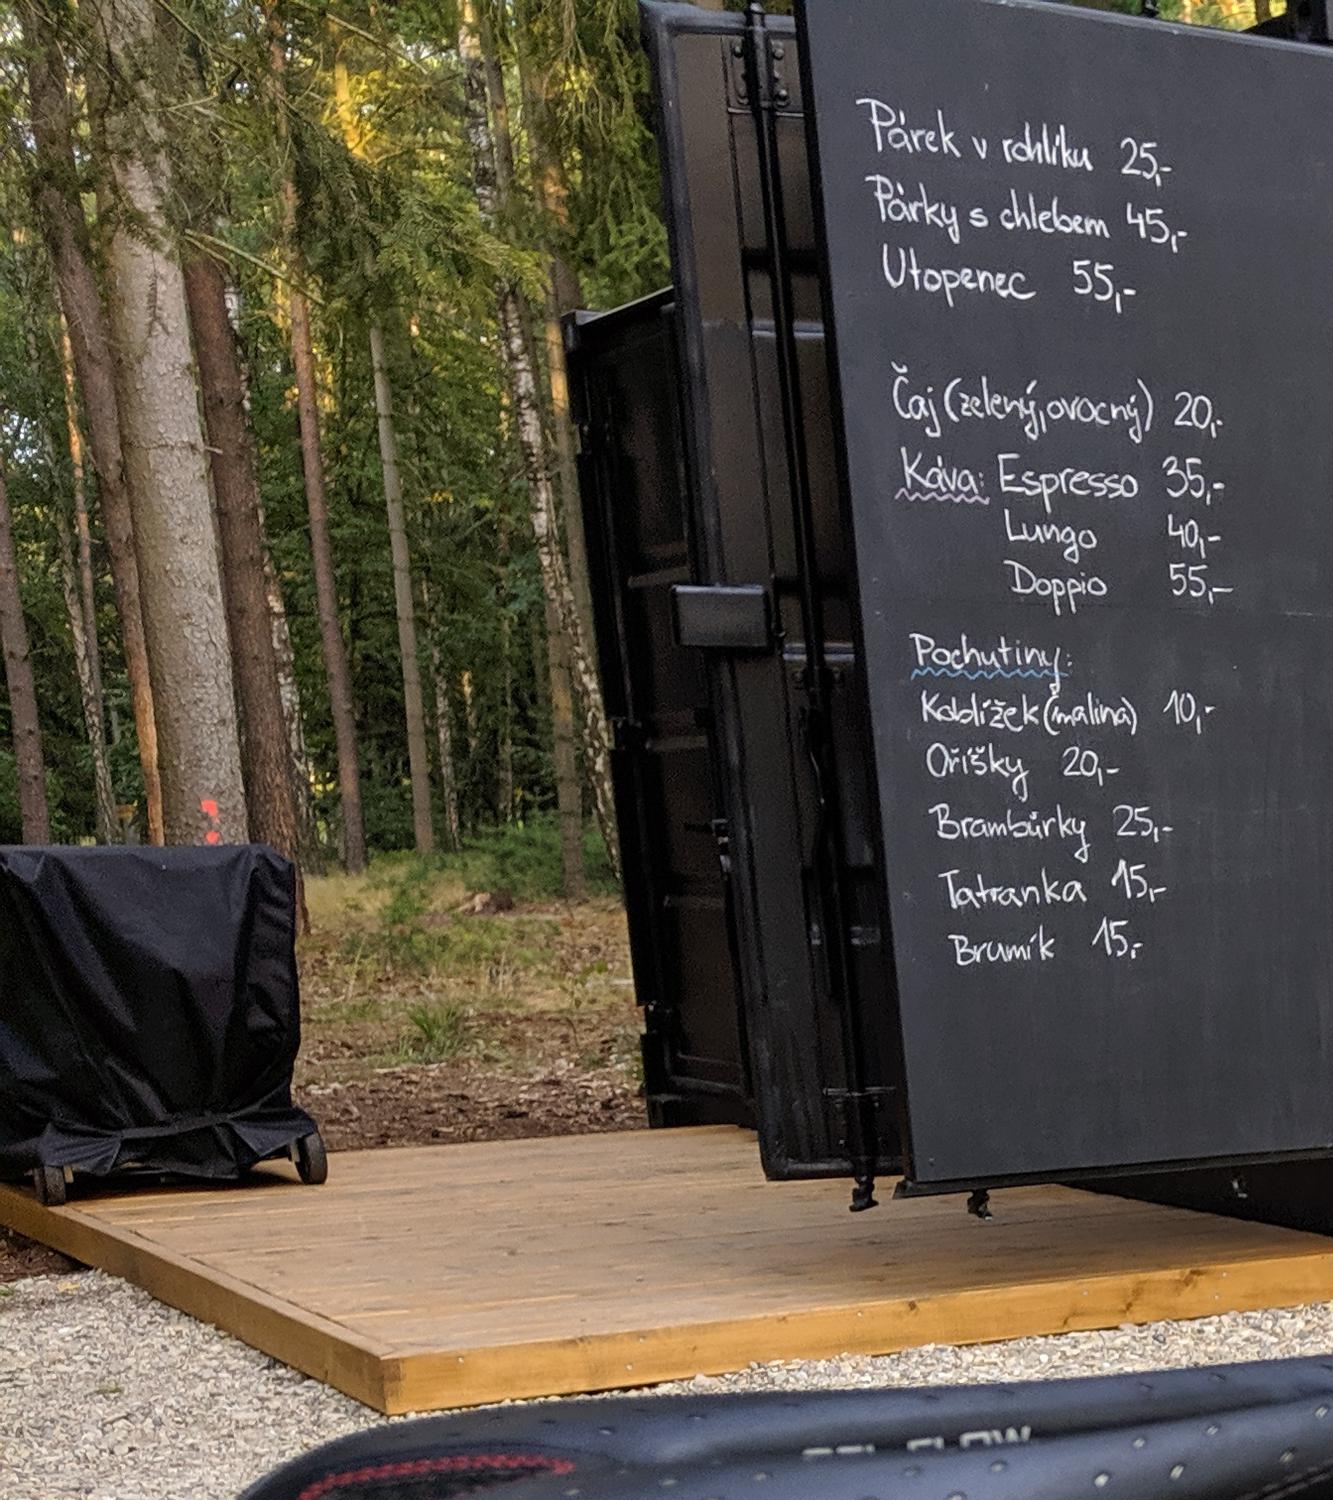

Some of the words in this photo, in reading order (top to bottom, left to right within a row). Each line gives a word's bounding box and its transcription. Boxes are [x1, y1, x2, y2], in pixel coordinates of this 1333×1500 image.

[856, 98, 961, 158] Párek
[972, 136, 988, 159] v
[1120, 137, 1172, 186] 25,-
[865, 174, 960, 244] Párky
[970, 204, 989, 228] s
[1000, 188, 1110, 239] chlebem
[1127, 202, 1188, 253] 45,-
[883, 243, 1036, 307] Utopenec
[1073, 260, 1136, 313] 55,-
[891, 361, 941, 437] Čaj
[1174, 391, 1223, 438] 20,-
[901, 447, 985, 492] Káva:
[998, 453, 1139, 514] Espresso
[1163, 456, 1225, 506] 35,-
[1004, 508, 1097, 563] Lungo
[1168, 514, 1222, 558] 40,-
[1004, 560, 1108, 615] Doppio
[1170, 563, 1234, 604] 55,-
[909, 633, 1073, 695] Pochutiny:
[920, 690, 1040, 733] Koblížek
[1043, 692, 1138, 736] (malina)
[1163, 690, 1217, 734] 10,-
[926, 742, 1029, 802] Oříšky
[1063, 747, 1120, 785] 20,-
[928, 803, 1091, 863] Brambůrky
[1113, 805, 1173, 843] 25,-
[938, 868, 1087, 911] Tatranka
[1111, 859, 1168, 903] 15,-
[948, 925, 1054, 966] Brumík
[1091, 916, 1144, 959] 15,-
